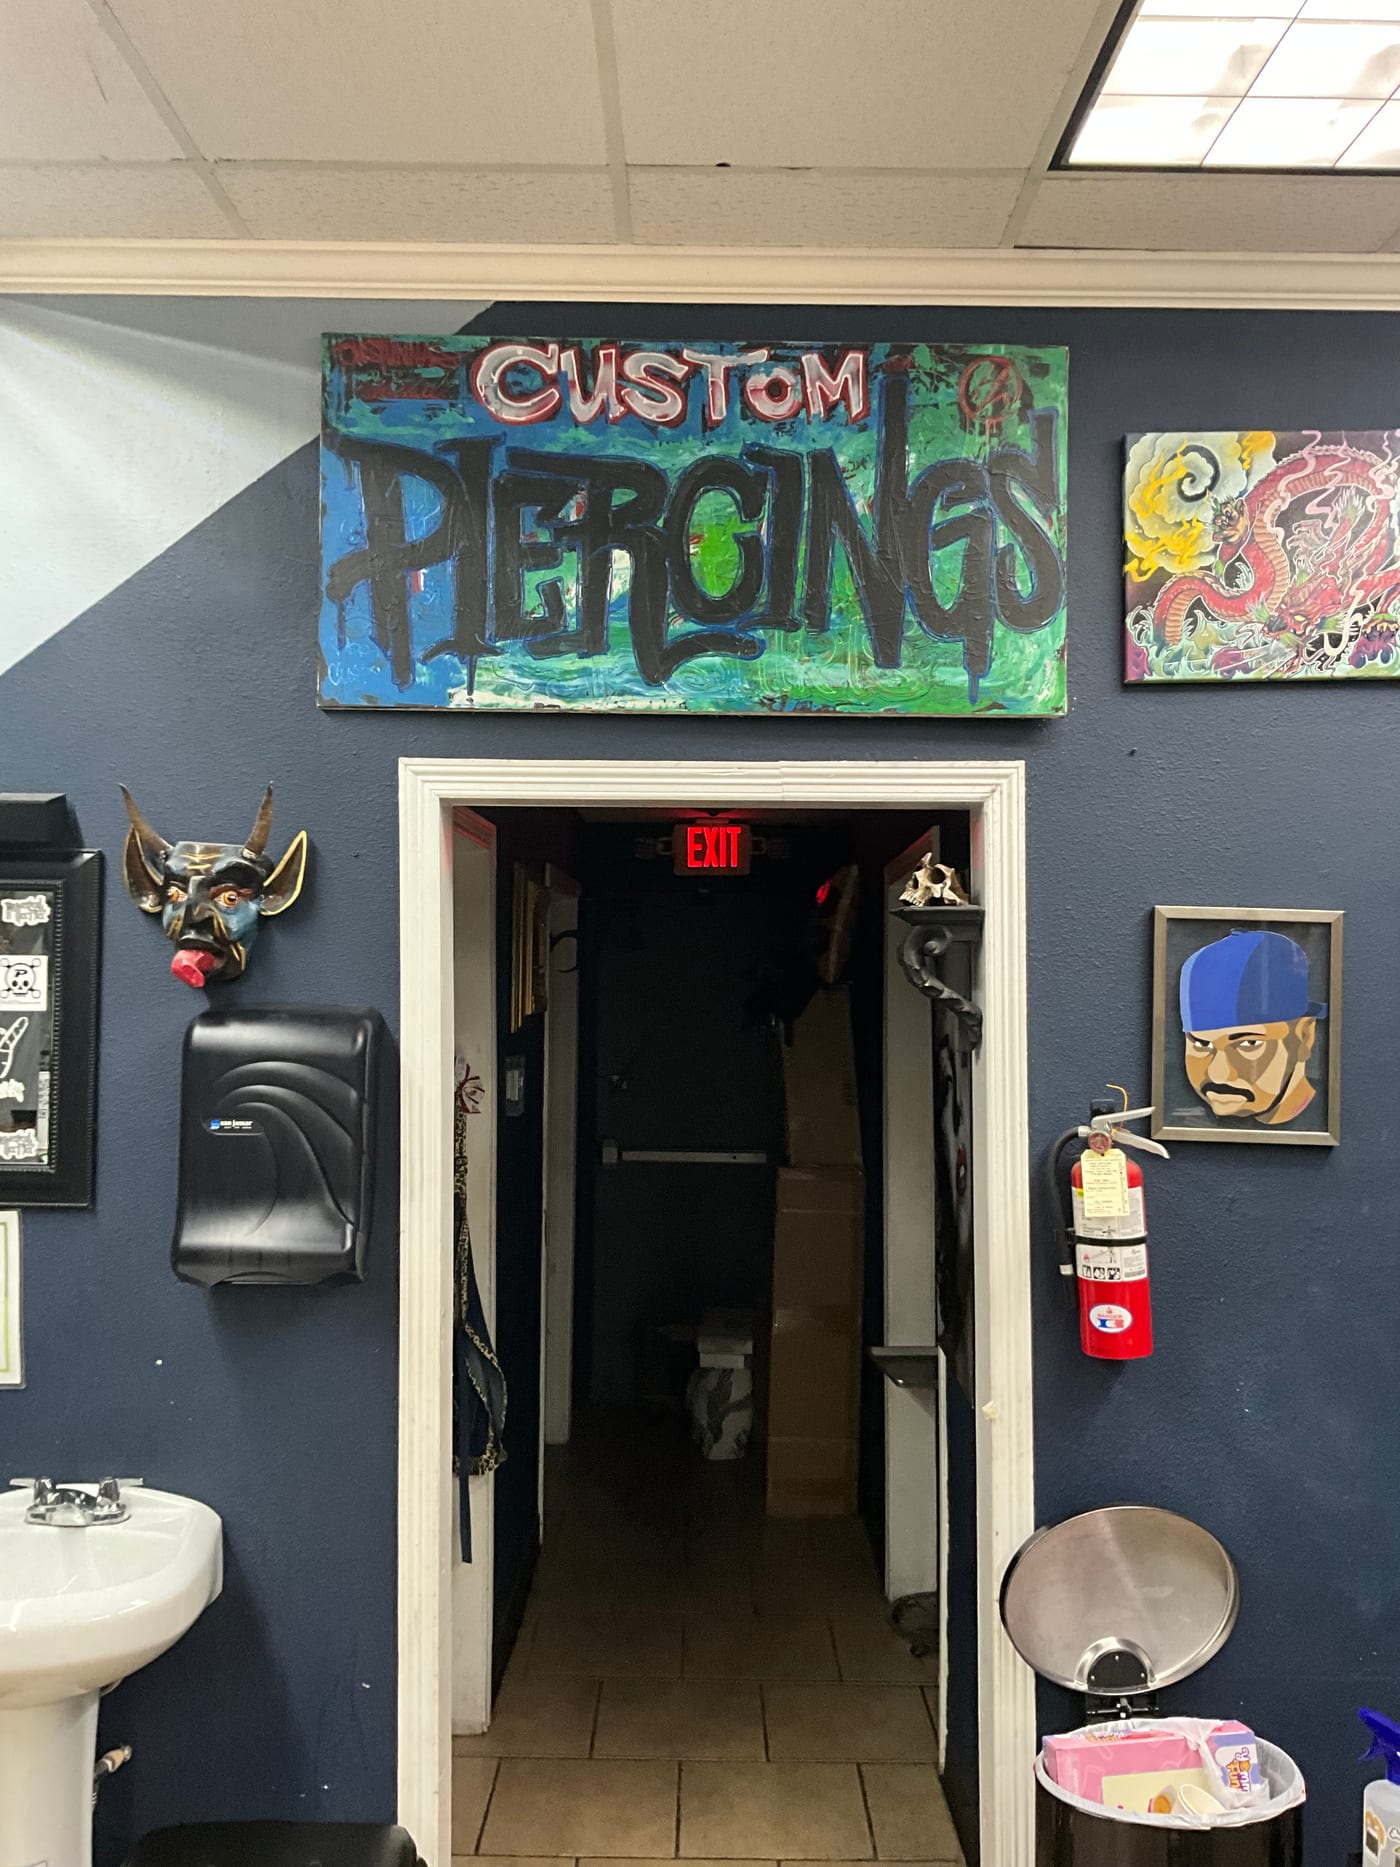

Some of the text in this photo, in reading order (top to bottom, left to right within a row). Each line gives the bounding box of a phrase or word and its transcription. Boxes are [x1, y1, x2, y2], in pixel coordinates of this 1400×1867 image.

[470, 343, 869, 425] CUSTOM
[325, 372, 1066, 704] PIERCINGS
[687, 826, 742, 868] EXIT
